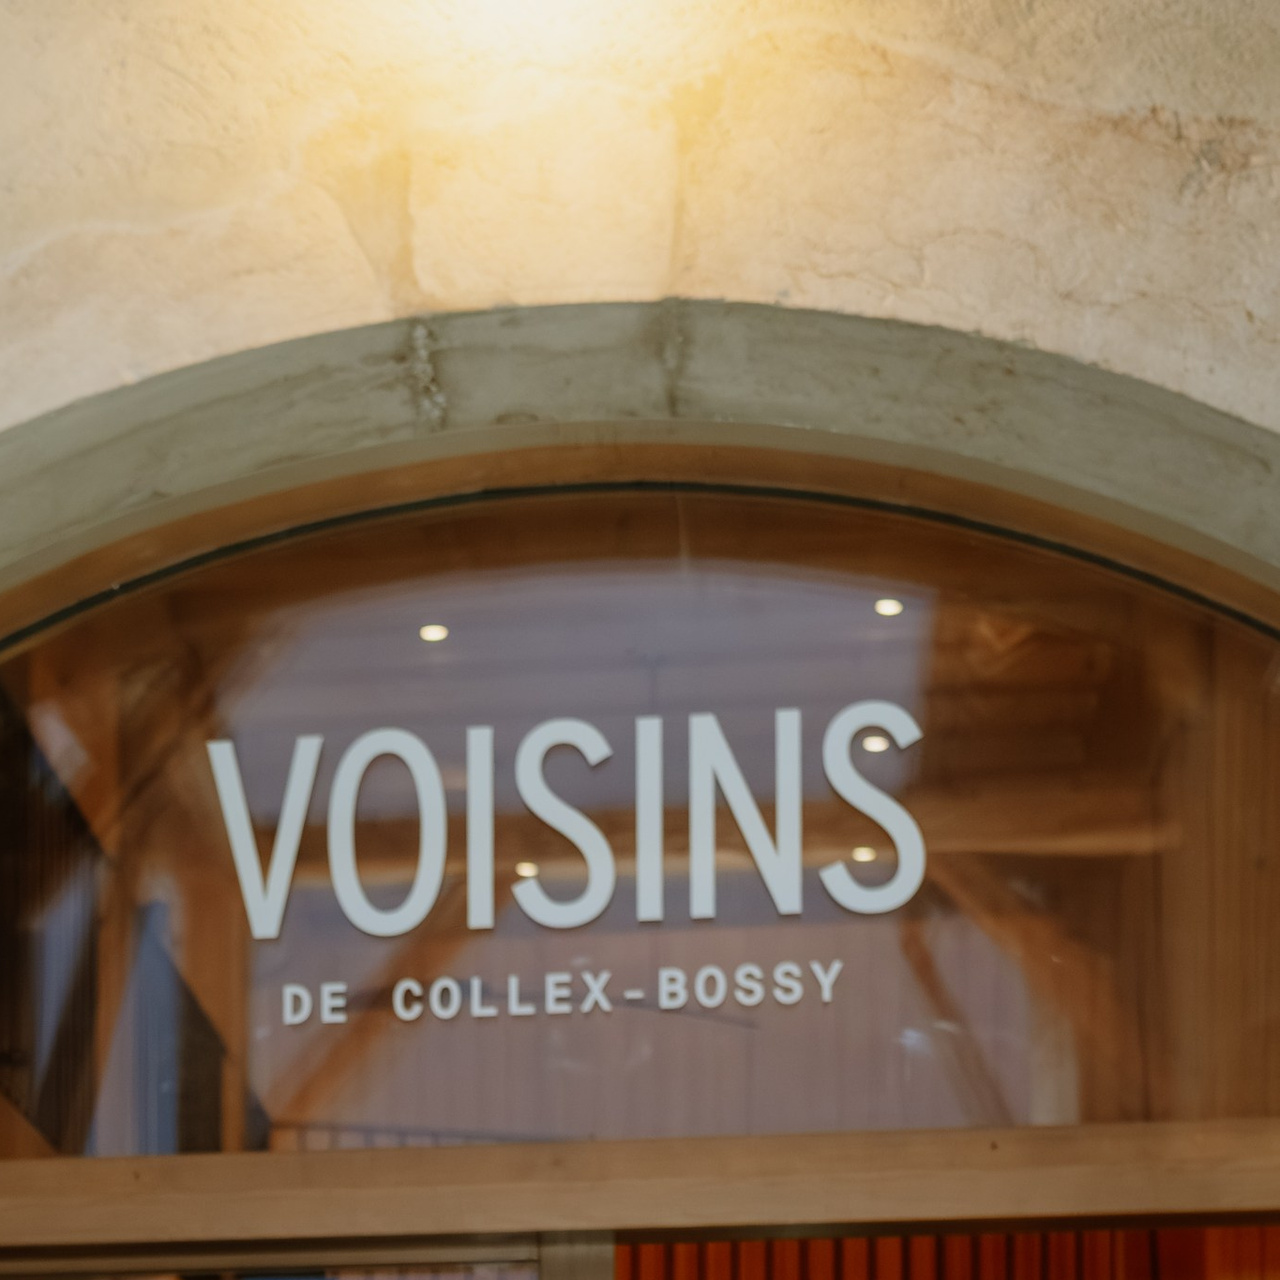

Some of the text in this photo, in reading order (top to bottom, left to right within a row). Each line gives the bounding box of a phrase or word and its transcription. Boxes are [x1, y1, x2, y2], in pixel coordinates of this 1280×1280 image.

[207, 700, 926, 940] VOISINS
[281, 959, 844, 1026] DE COLLEX-BOSSY
